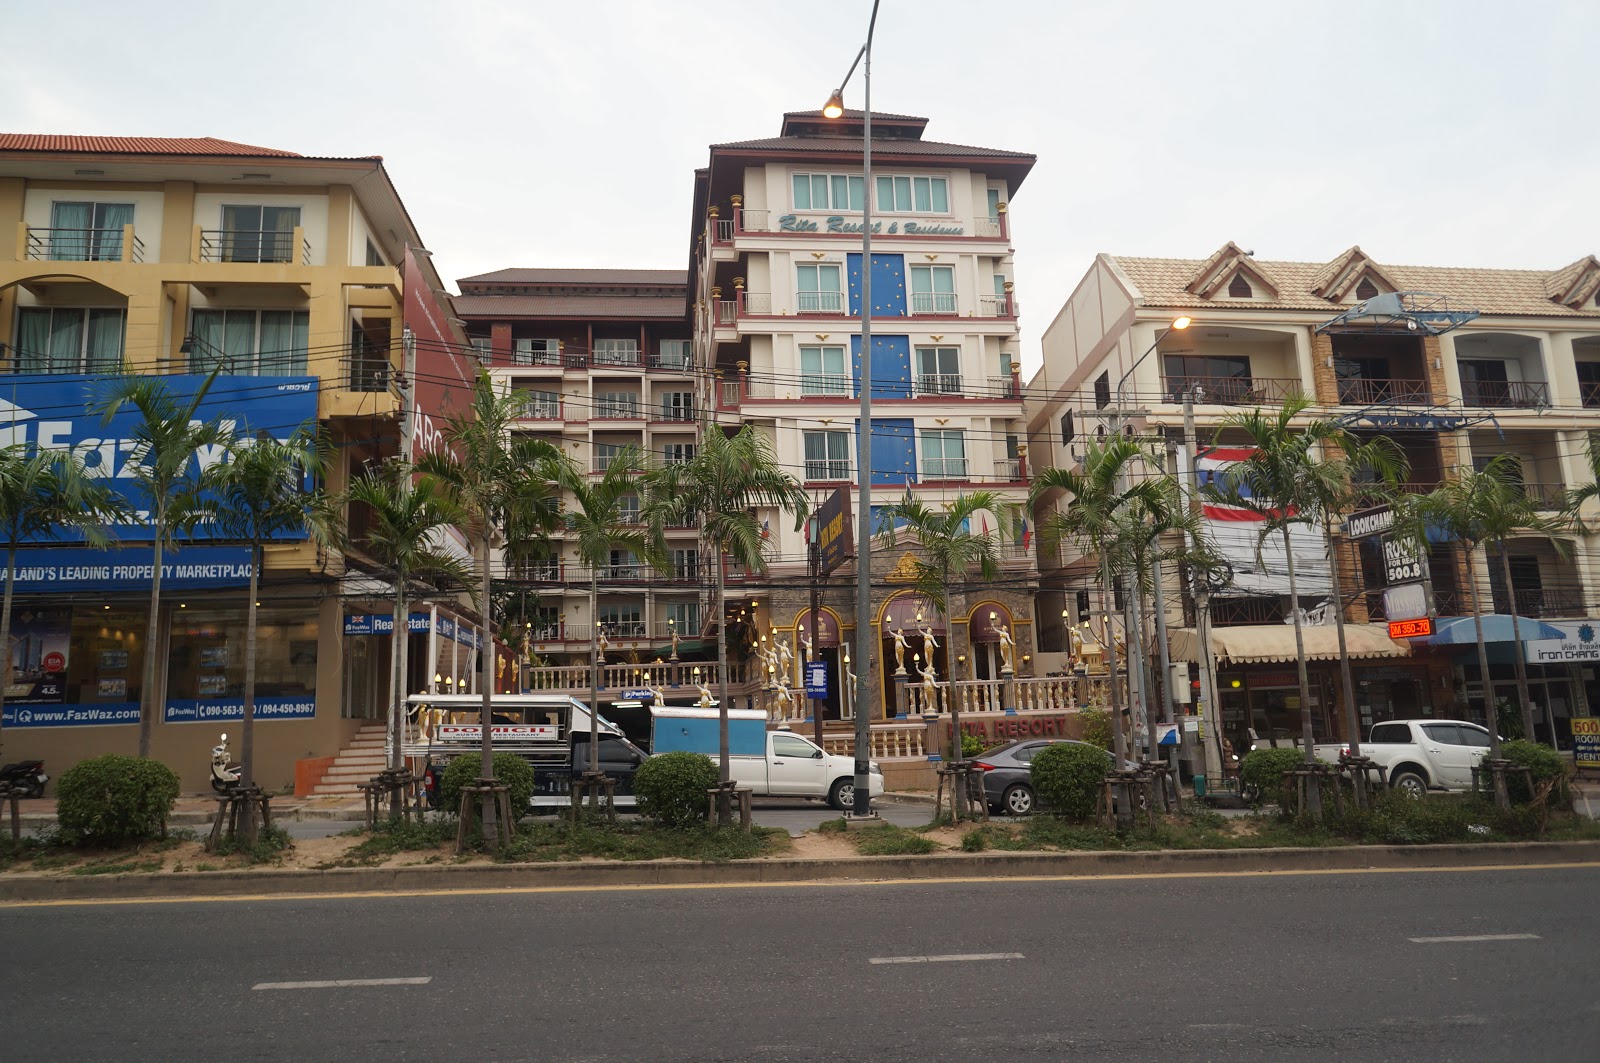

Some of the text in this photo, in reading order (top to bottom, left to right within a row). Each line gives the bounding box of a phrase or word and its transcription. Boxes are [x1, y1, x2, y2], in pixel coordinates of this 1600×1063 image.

[778, 215, 964, 236] Rita Resot & Residence
[1388, 559, 1401, 567] FOR
[60, 566, 109, 580] LEADING
[374, 619, 394, 630] Rea
[407, 618, 431, 629] state
[1402, 624, 1416, 634] 350
[1565, 650, 1599, 659] CHANG
[631, 690, 653, 698] Parking
[34, 709, 141, 721] www.FazWaz.com
[206, 705, 257, 716] 090-563-90
[262, 703, 314, 714] 094-450-8967
[993, 717, 1067, 737] RESORT
[1574, 721, 1599, 733] 500
